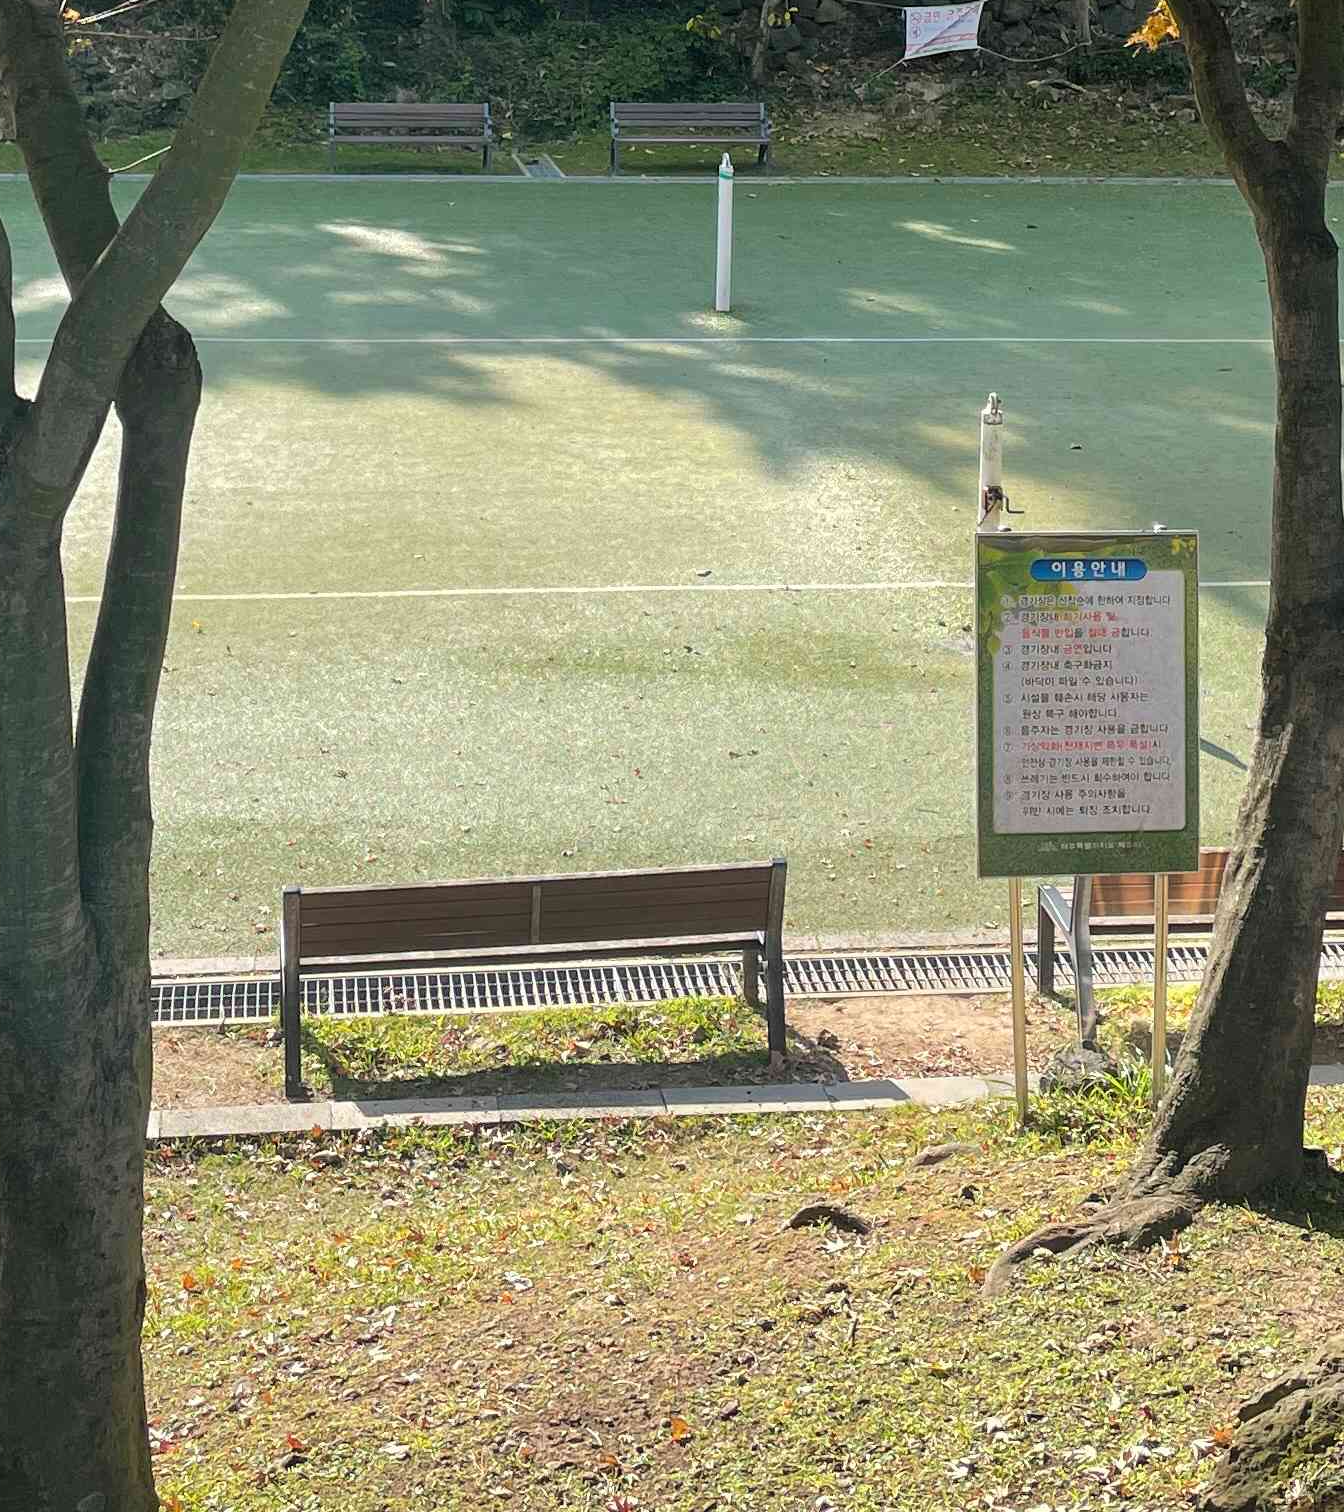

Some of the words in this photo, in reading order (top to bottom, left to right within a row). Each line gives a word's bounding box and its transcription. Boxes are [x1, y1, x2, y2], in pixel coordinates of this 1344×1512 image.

[1051, 561, 1126, 578] 이용안내
[1021, 644, 1059, 654] 경기장내
[1063, 643, 1113, 654] 금연입니다
[1021, 660, 1059, 671] 경기장내
[1021, 773, 1058, 784] 쓰레기는
